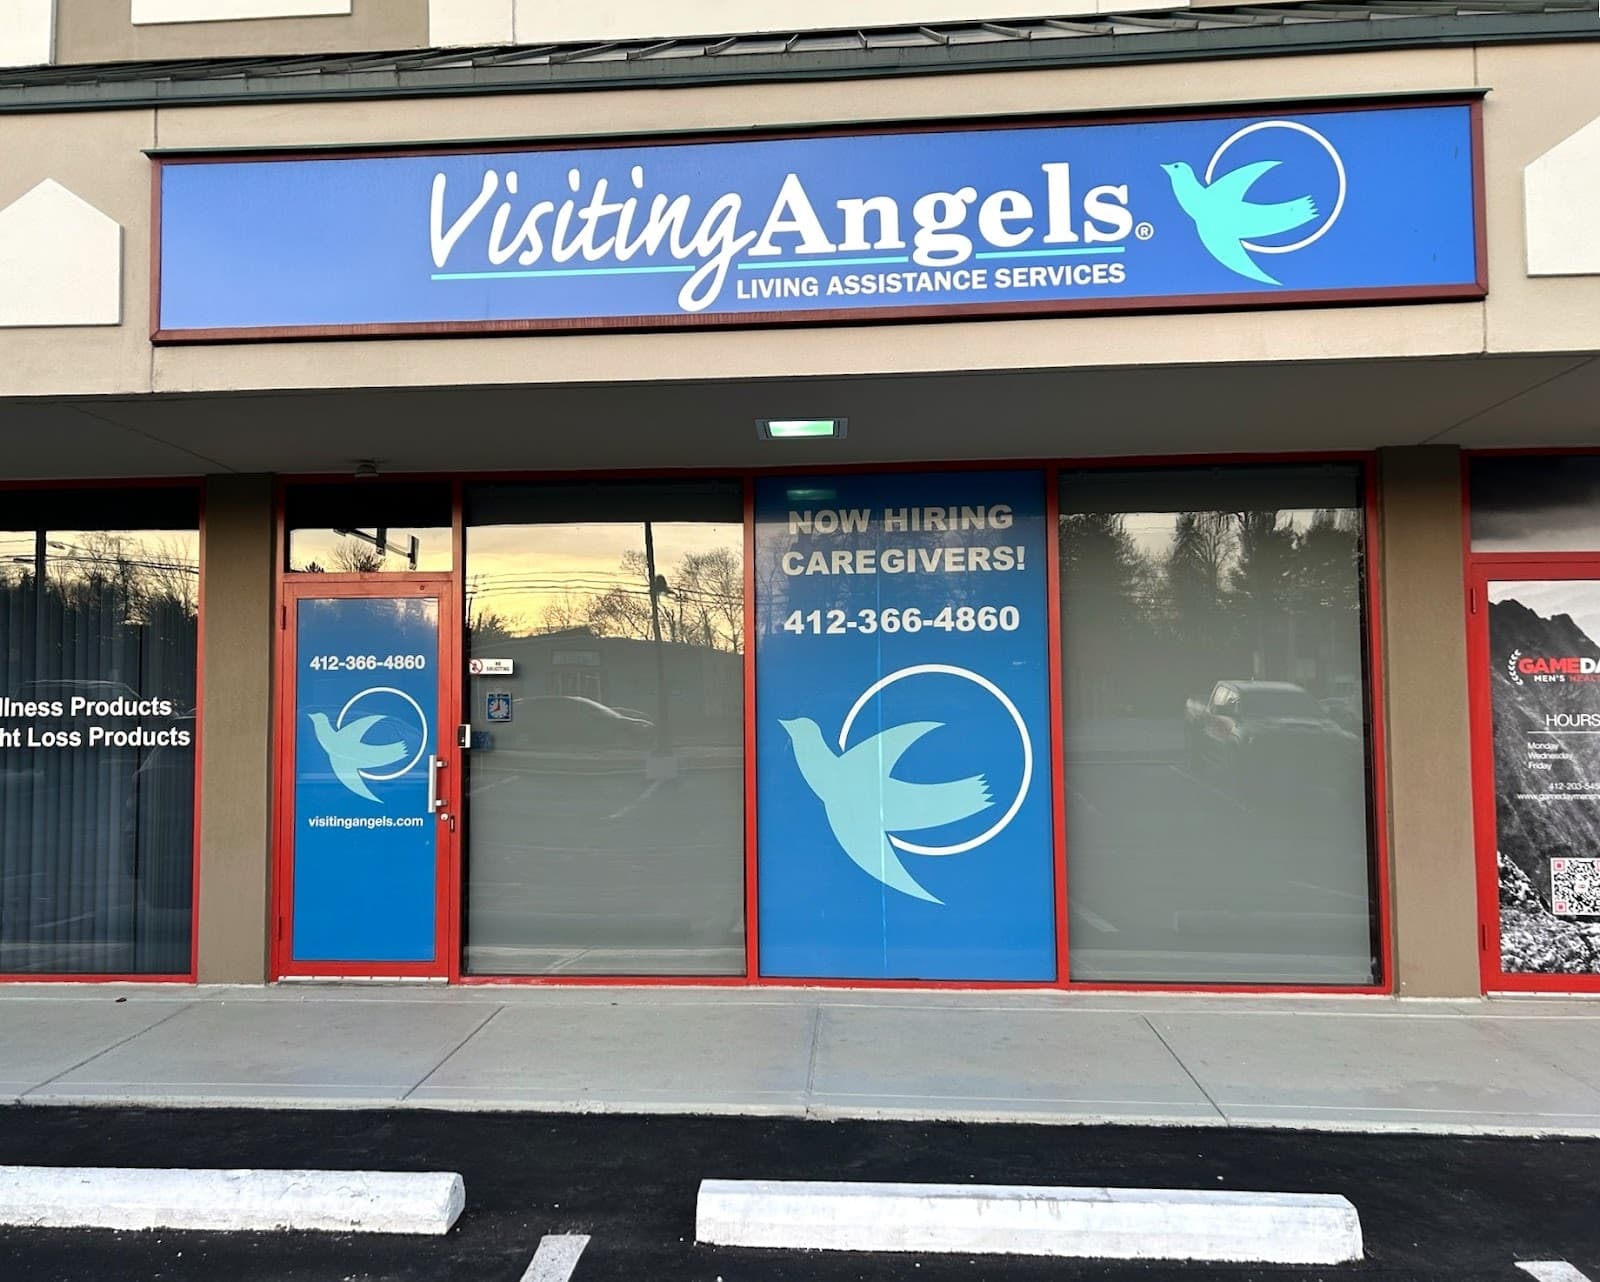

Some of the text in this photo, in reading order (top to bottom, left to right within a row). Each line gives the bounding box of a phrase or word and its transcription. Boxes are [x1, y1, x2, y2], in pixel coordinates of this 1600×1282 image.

[736, 263, 1126, 300] LIVING ASSISTANCE SERVICES
[788, 504, 1014, 535] NOW HIRING
[781, 545, 1026, 576] CAREGIVERS!
[783, 605, 1020, 635] 412-366-4860
[309, 654, 426, 671] 412-366-4860
[1533, 674, 1566, 683] MEN'S
[70, 695, 173, 717] Products
[1545, 713, 1600, 727] HOURS
[27, 727, 82, 747] Loss
[89, 726, 191, 747] Products
[1527, 742, 1559, 752] Monday
[1527, 752, 1573, 762] Wednesday
[1528, 761, 1552, 771] Friday
[308, 815, 424, 829] visitingangels.com
